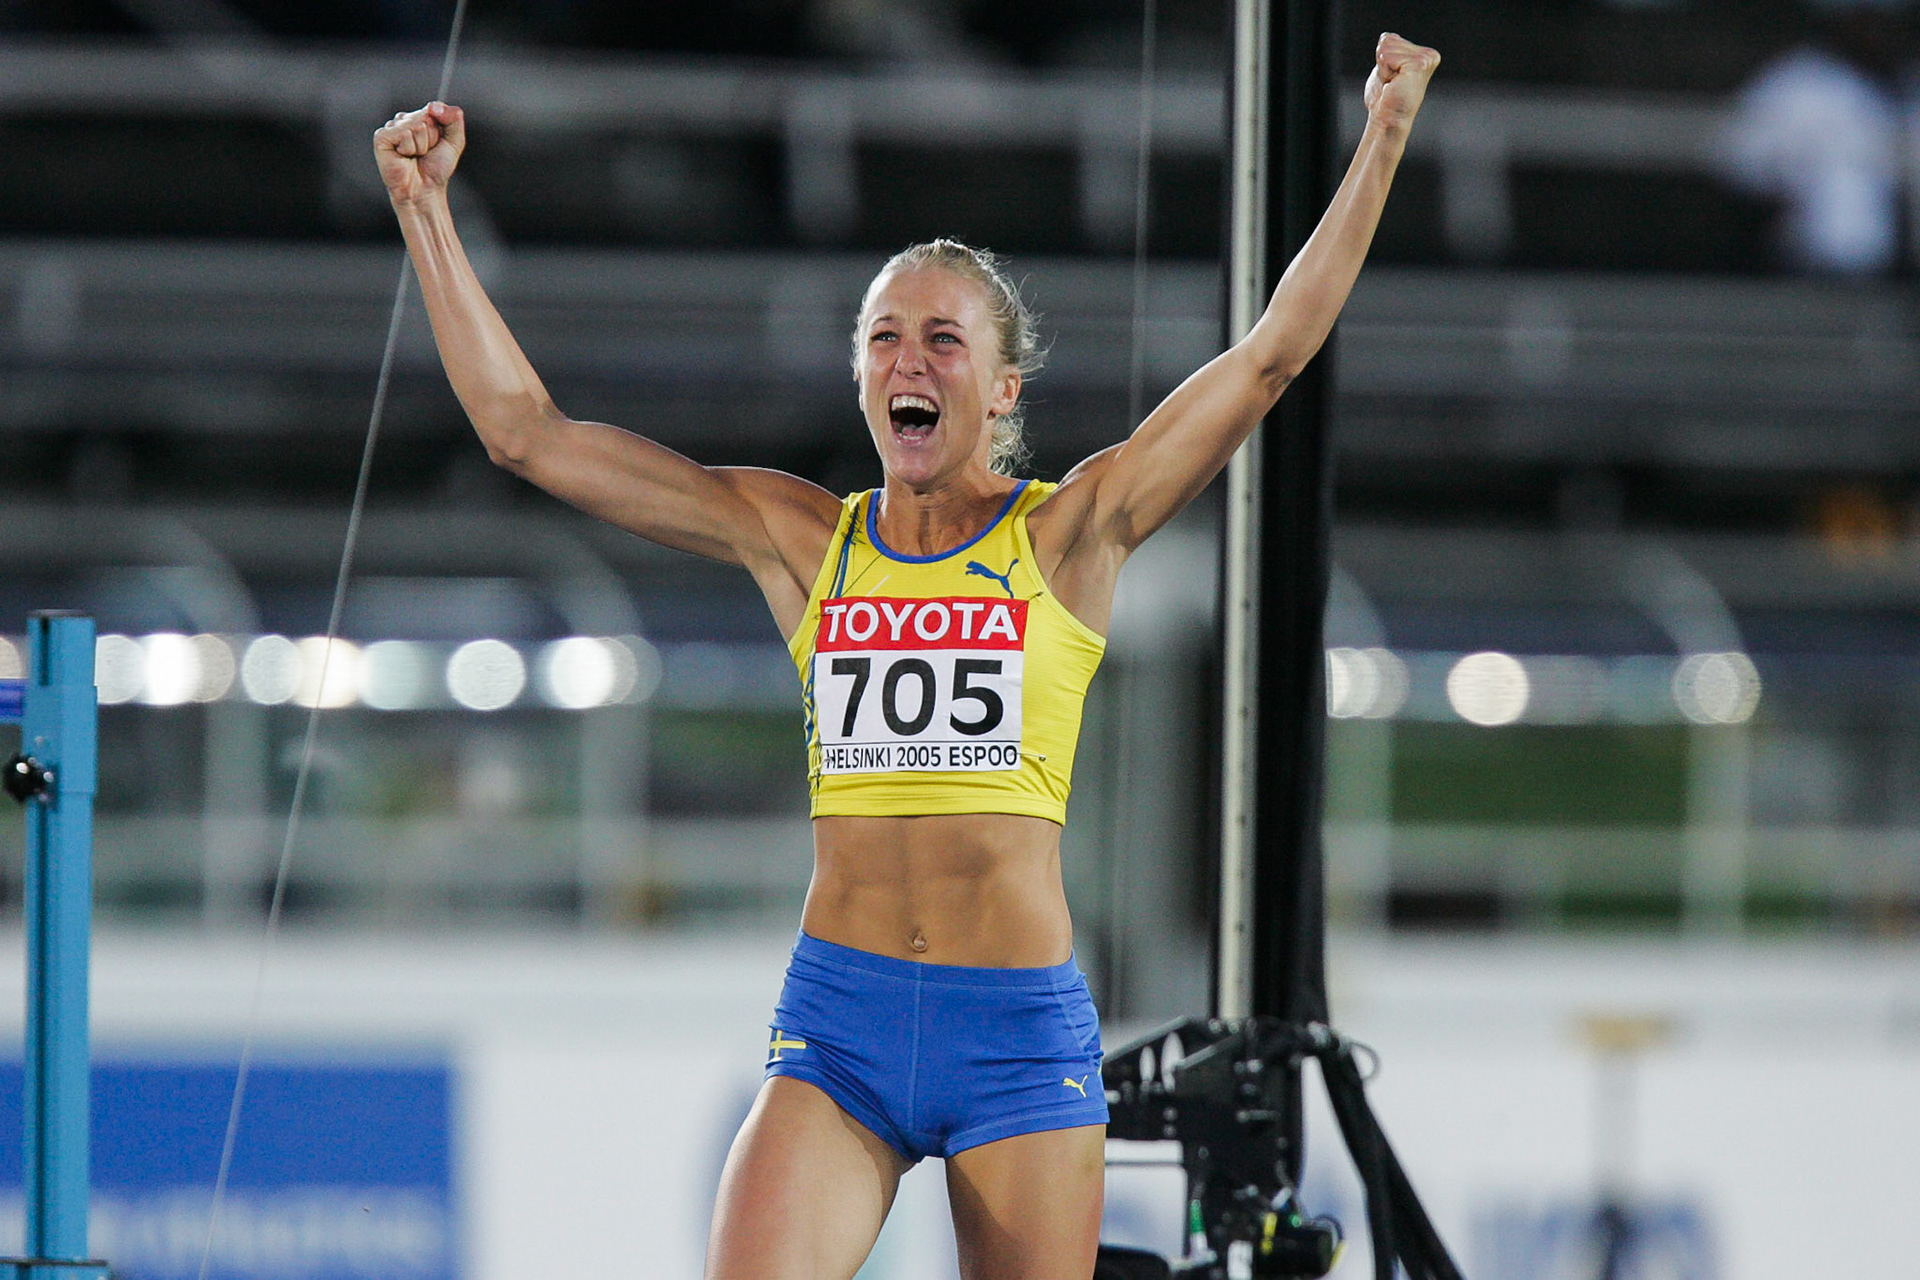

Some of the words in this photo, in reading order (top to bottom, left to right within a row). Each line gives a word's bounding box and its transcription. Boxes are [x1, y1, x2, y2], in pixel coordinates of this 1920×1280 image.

[824, 601, 1018, 642] TOYOTA
[831, 657, 1004, 737] 705
[826, 745, 891, 769] HELSINKI
[896, 746, 941, 767] 2005
[949, 744, 1017, 767] ESPOO
